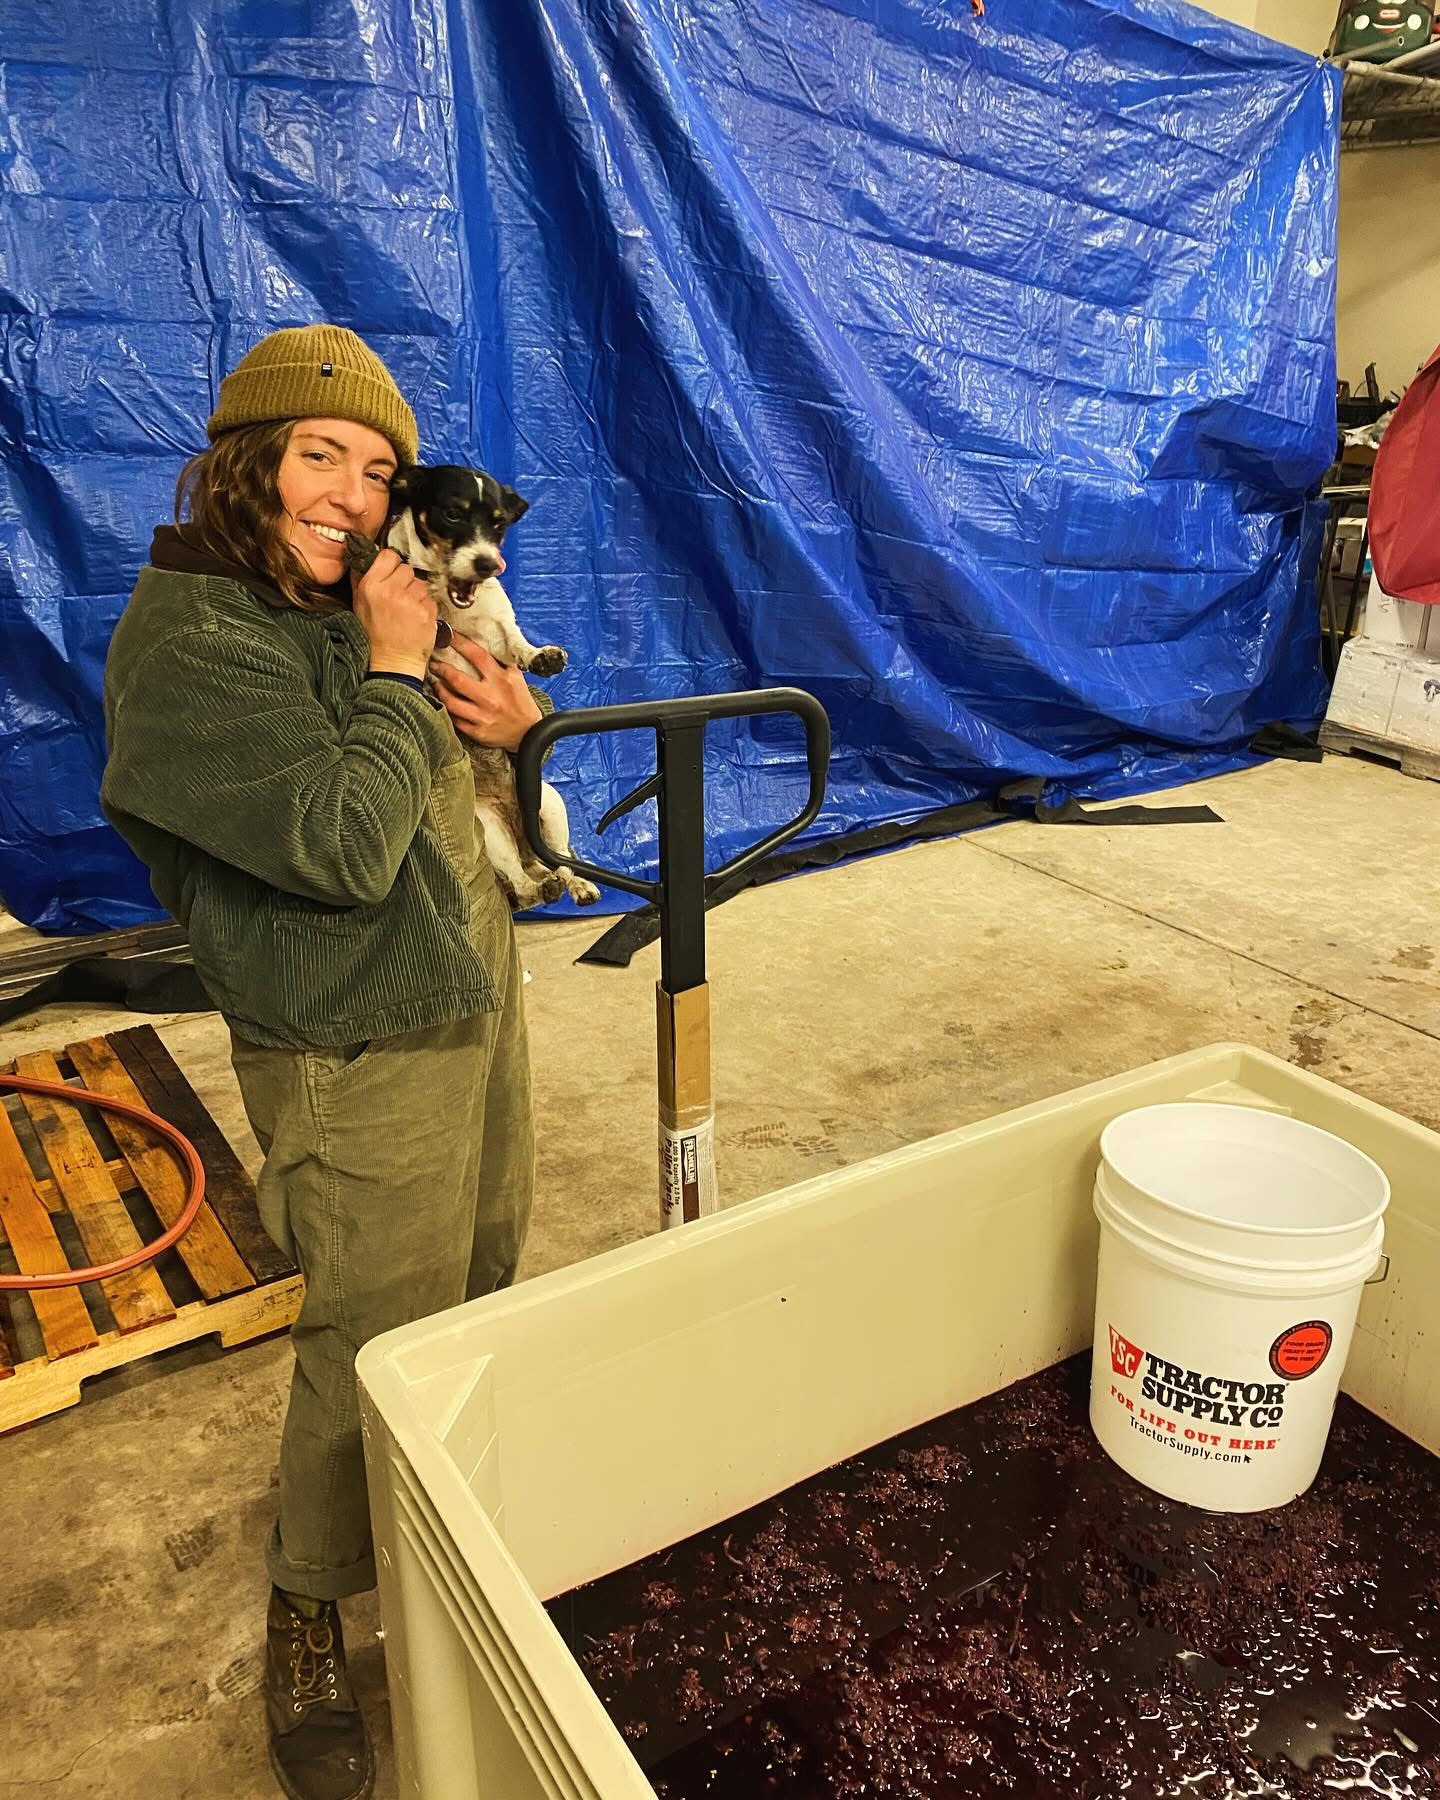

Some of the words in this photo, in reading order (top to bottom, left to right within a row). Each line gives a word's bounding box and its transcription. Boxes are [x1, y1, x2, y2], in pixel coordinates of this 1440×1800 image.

[664, 1137, 673, 1175] Pallet
[684, 1140, 697, 1183] FRANKLIN
[664, 1177, 675, 1209] Jack
[1110, 1330, 1136, 1377] TSC
[1145, 1351, 1286, 1405] TRACTOR
[1111, 1385, 1134, 1413] FOR
[1139, 1407, 1177, 1434] LIFE
[1184, 1428, 1221, 1446] OUT
[1229, 1438, 1277, 1450] HERE
[1141, 1377, 1248, 1428] SUPPLY
[1129, 1415, 1241, 1464] TractorSupply.com
